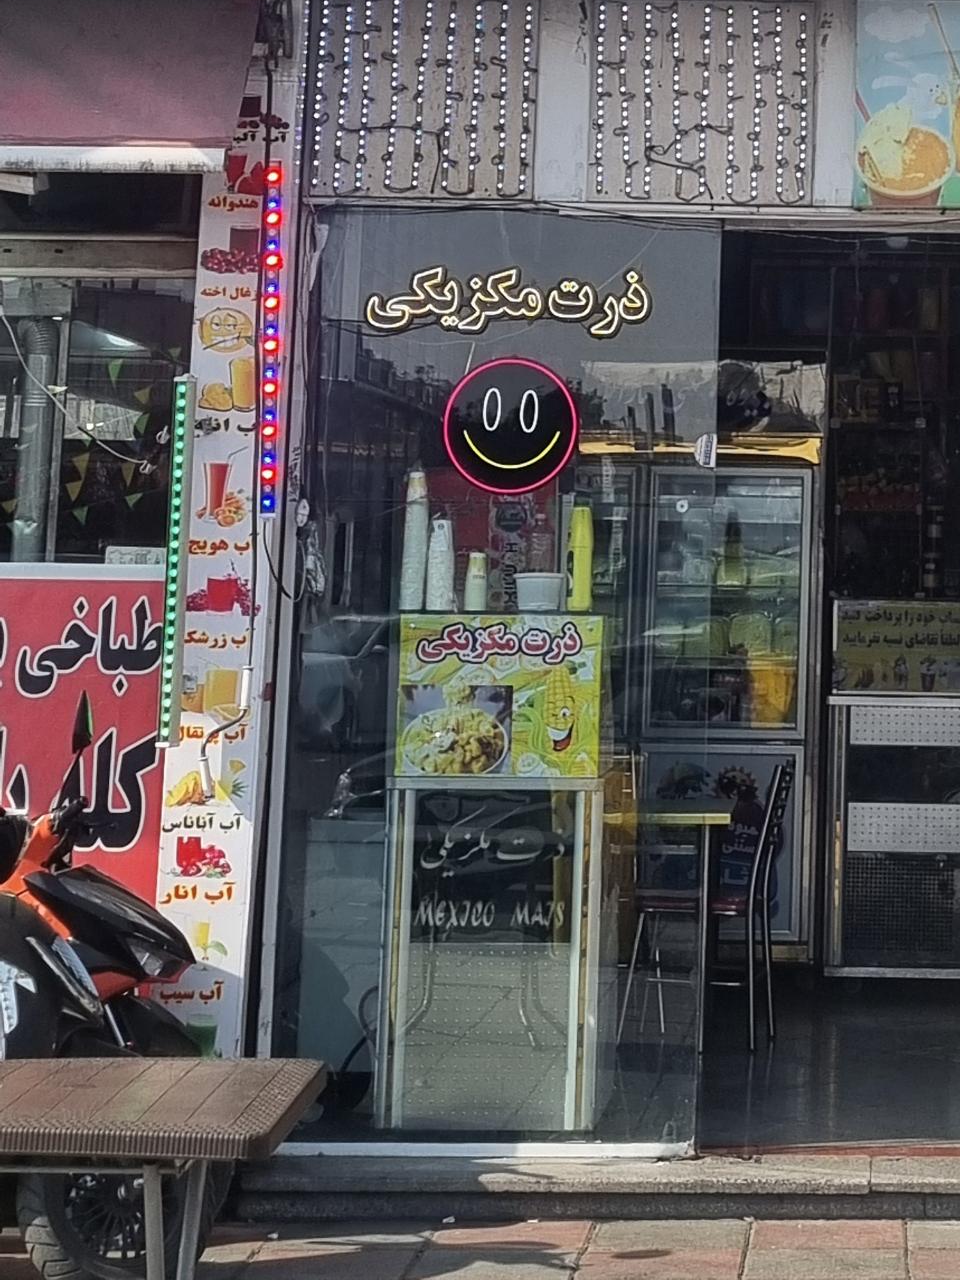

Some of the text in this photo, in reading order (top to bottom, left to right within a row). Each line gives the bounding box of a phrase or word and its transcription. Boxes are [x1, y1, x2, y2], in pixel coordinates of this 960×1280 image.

[208, 196, 260, 212] هندوانه
[230, 286, 257, 301] غال
[367, 267, 649, 336] ذرت مکزیکی
[188, 539, 229, 556] هویج
[15, 596, 163, 699] طباخی
[416, 621, 583, 664] ذرت مکزیکی
[224, 723, 248, 744] آب
[162, 812, 244, 832] آب آناناس
[160, 882, 236, 904] آب انار
[160, 981, 224, 1005] آب سیب
